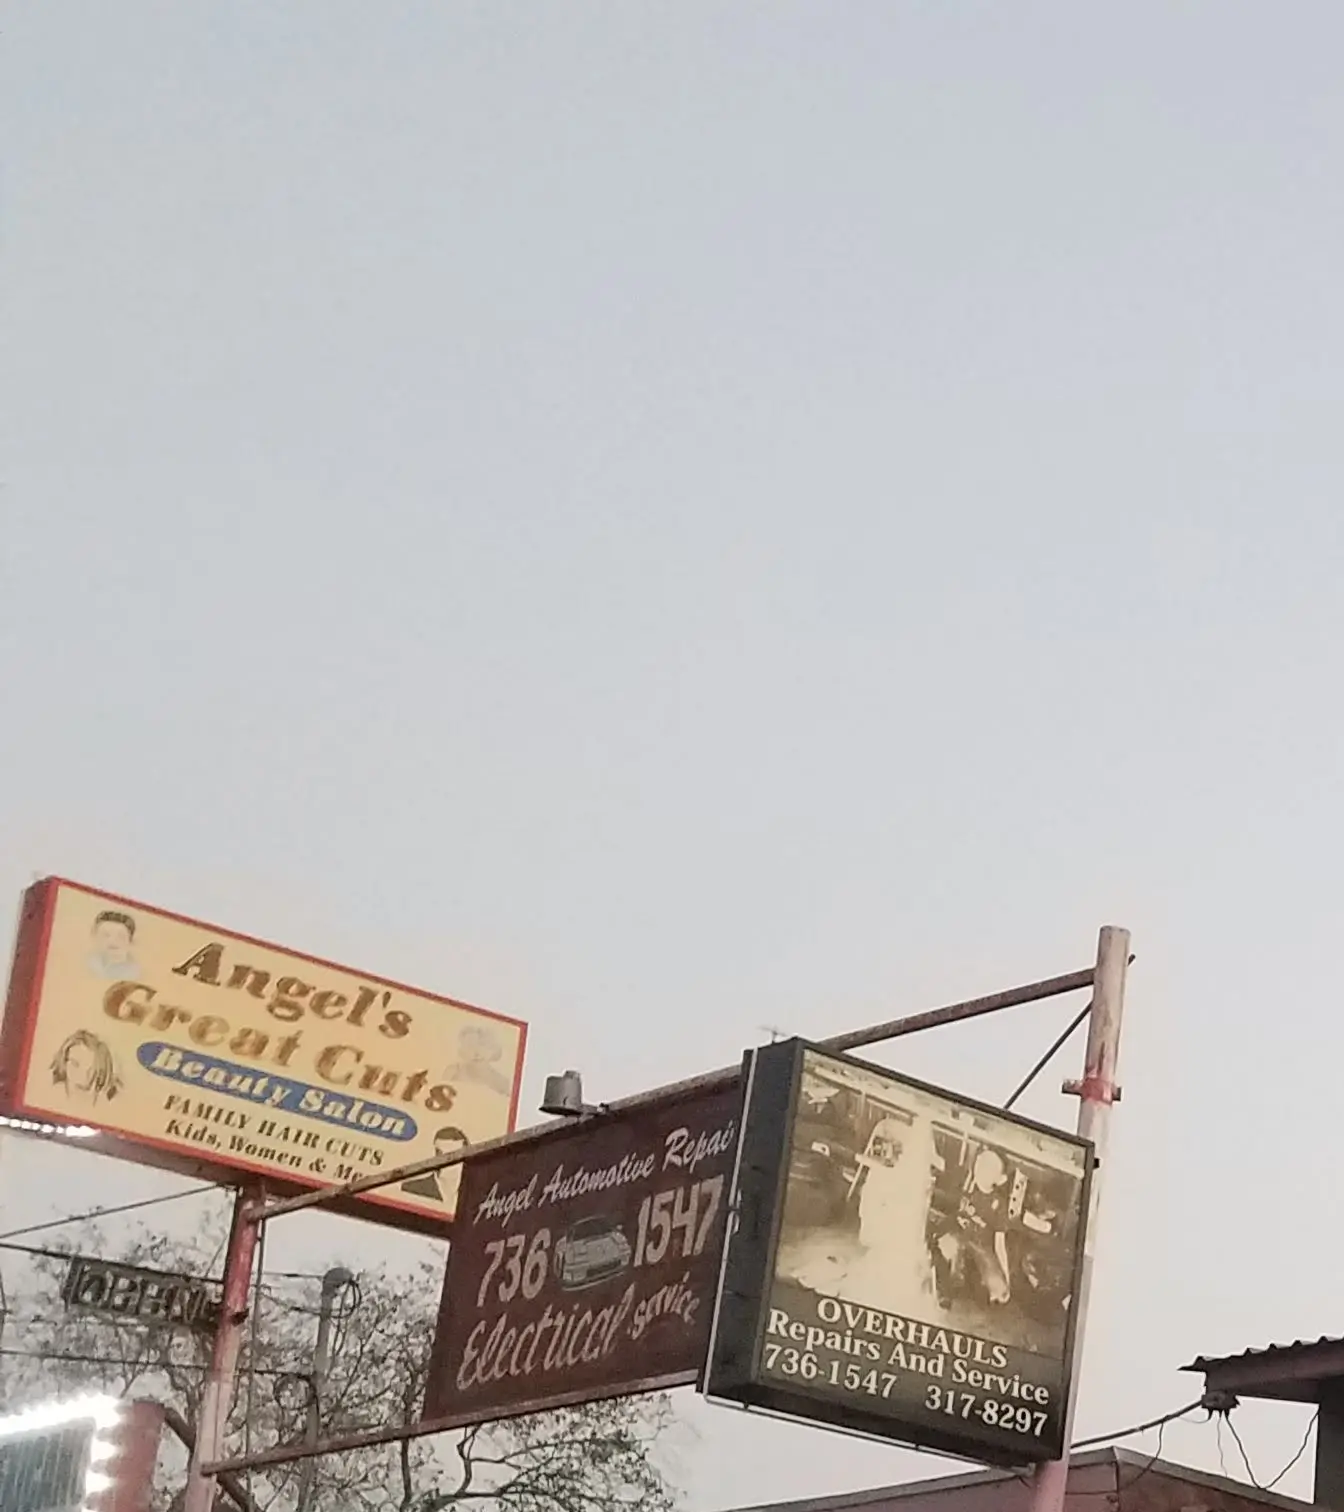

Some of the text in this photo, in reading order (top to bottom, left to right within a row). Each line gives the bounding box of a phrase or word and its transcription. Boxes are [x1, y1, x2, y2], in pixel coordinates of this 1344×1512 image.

[171, 942, 413, 1039] Angel's
[103, 980, 458, 1112] Great Cuts
[151, 1047, 409, 1137] Beauty Salon
[163, 1095, 384, 1167] FAMILY HAIR CUTS
[165, 1119, 365, 1185] Kids, Women & Me
[473, 1185, 535, 1230] Angel
[538, 1154, 656, 1210] Automotive
[477, 1174, 727, 1308] 736 1547
[456, 1281, 634, 1394] Electrical
[768, 1309, 1050, 1406] Repairs And Service
[817, 1298, 1009, 1369] OVERHAULS
[764, 1342, 1049, 1438] 736-1547 317-8297
